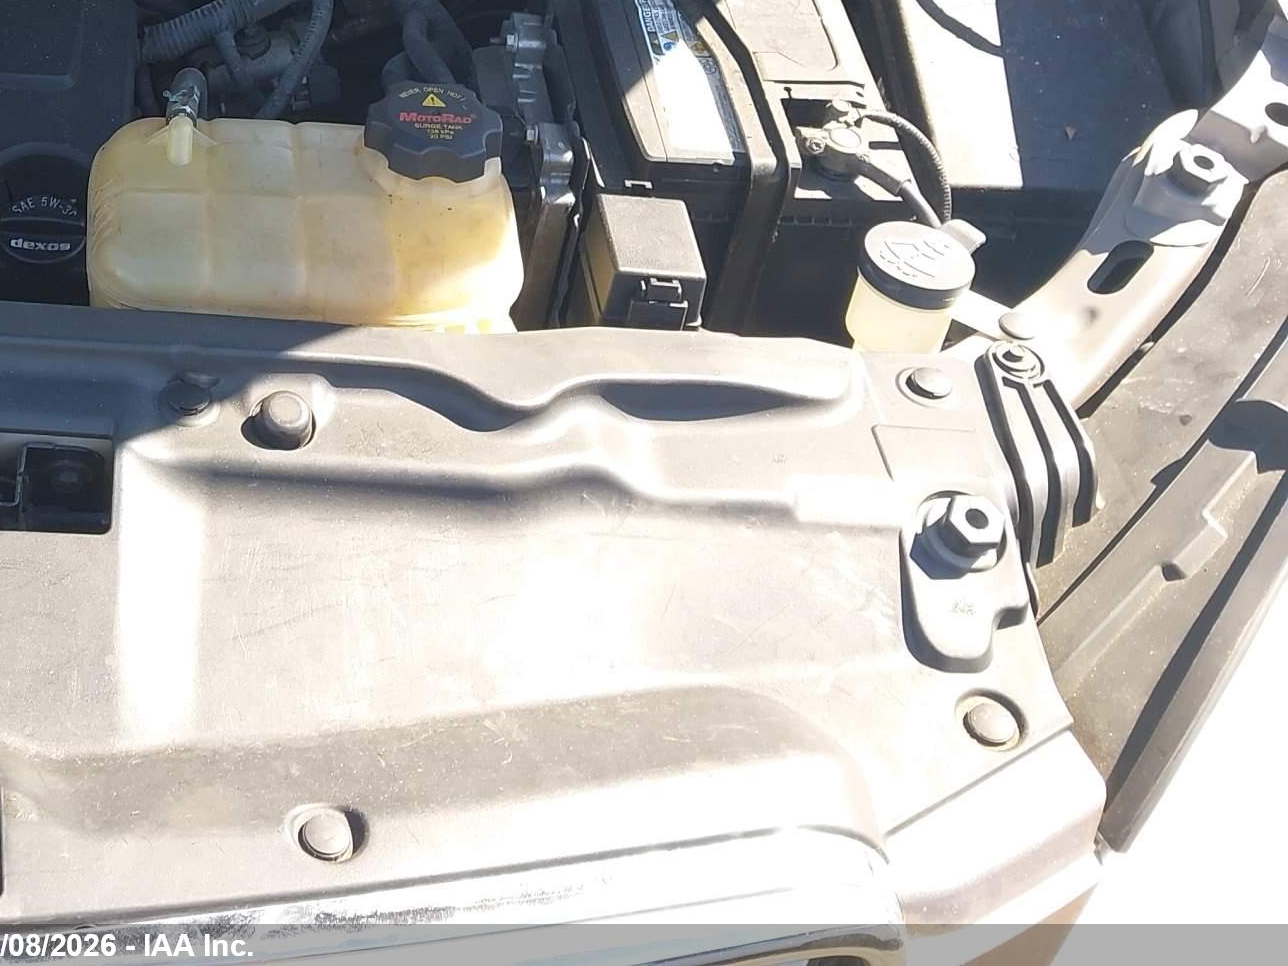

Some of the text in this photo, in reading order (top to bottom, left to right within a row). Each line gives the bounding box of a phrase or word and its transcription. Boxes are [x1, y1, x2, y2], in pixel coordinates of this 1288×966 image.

[642, 3, 656, 33] DANGE
[423, 86, 444, 94] OPEN
[12, 197, 36, 213] SAE
